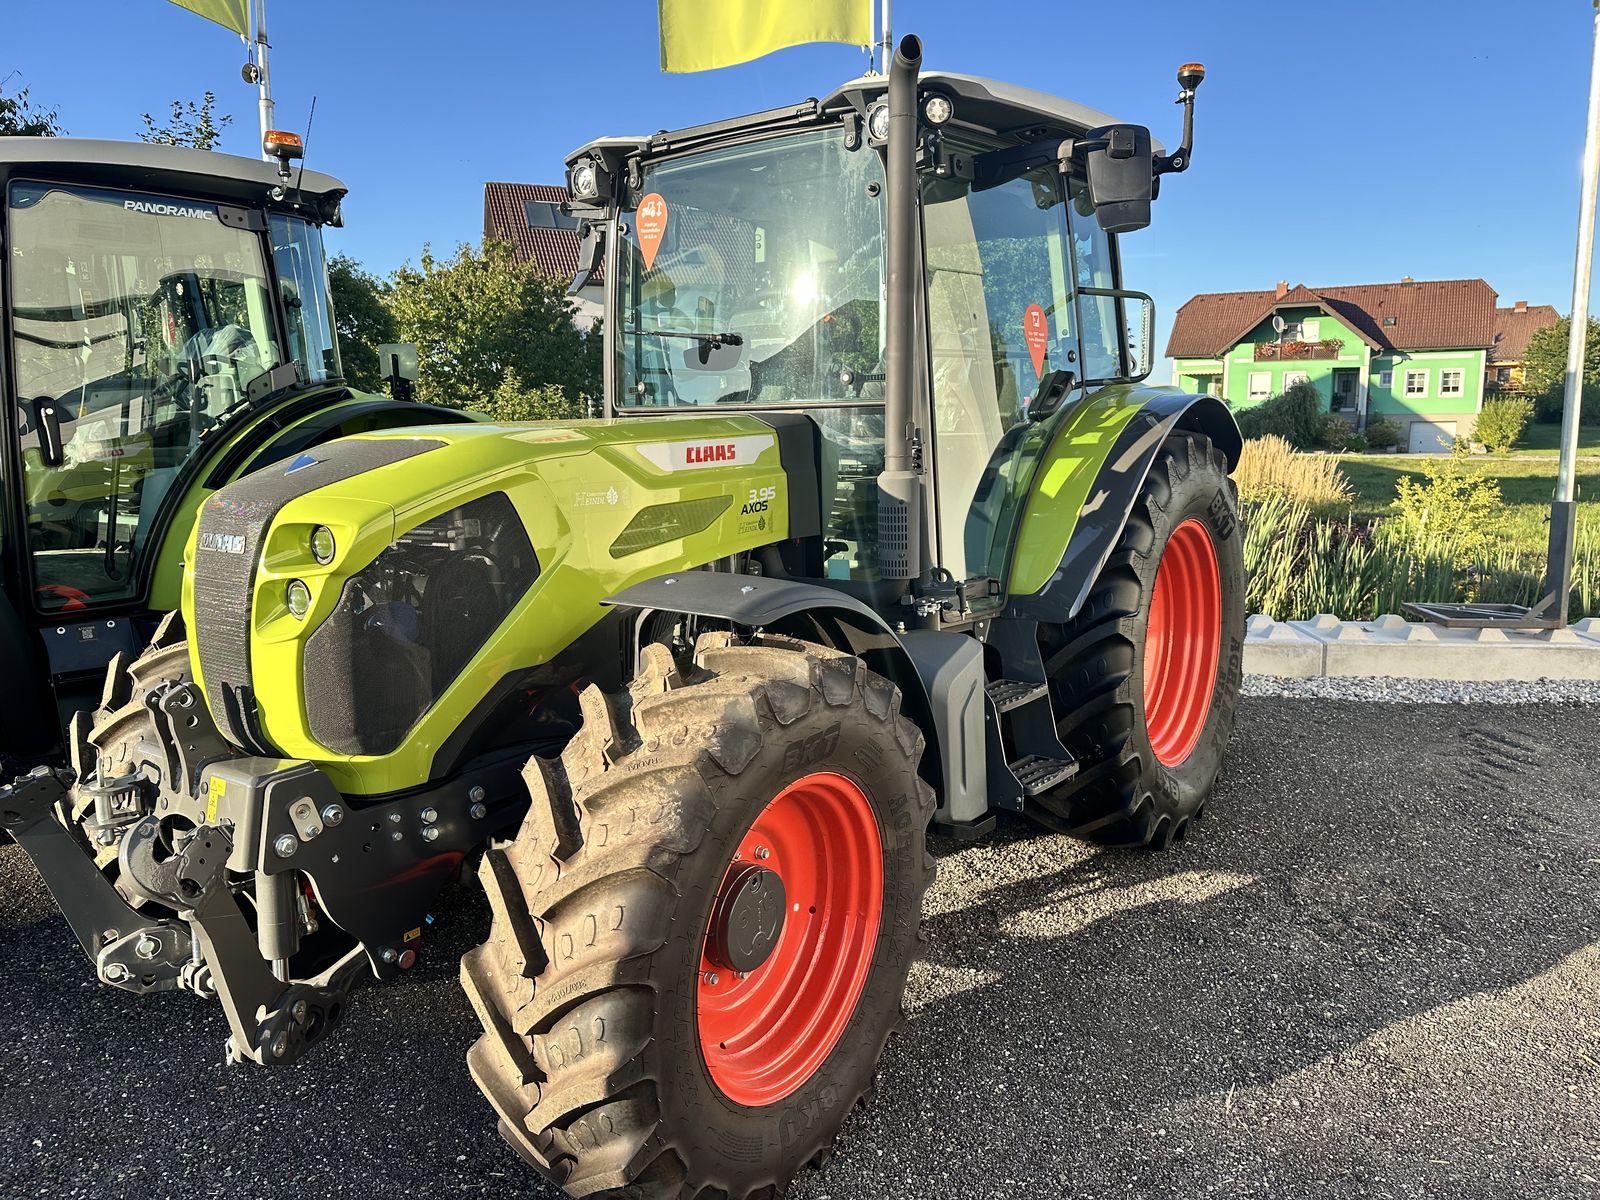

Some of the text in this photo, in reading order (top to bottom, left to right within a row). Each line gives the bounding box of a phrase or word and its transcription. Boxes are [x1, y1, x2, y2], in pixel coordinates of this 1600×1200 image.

[123, 200, 213, 220] PANORAMIC
[686, 444, 736, 463] CLAAS
[749, 486, 776, 503] 3.95
[740, 500, 769, 516] AXOS
[1208, 488, 1236, 541] BKT
[783, 721, 842, 770] BKT
